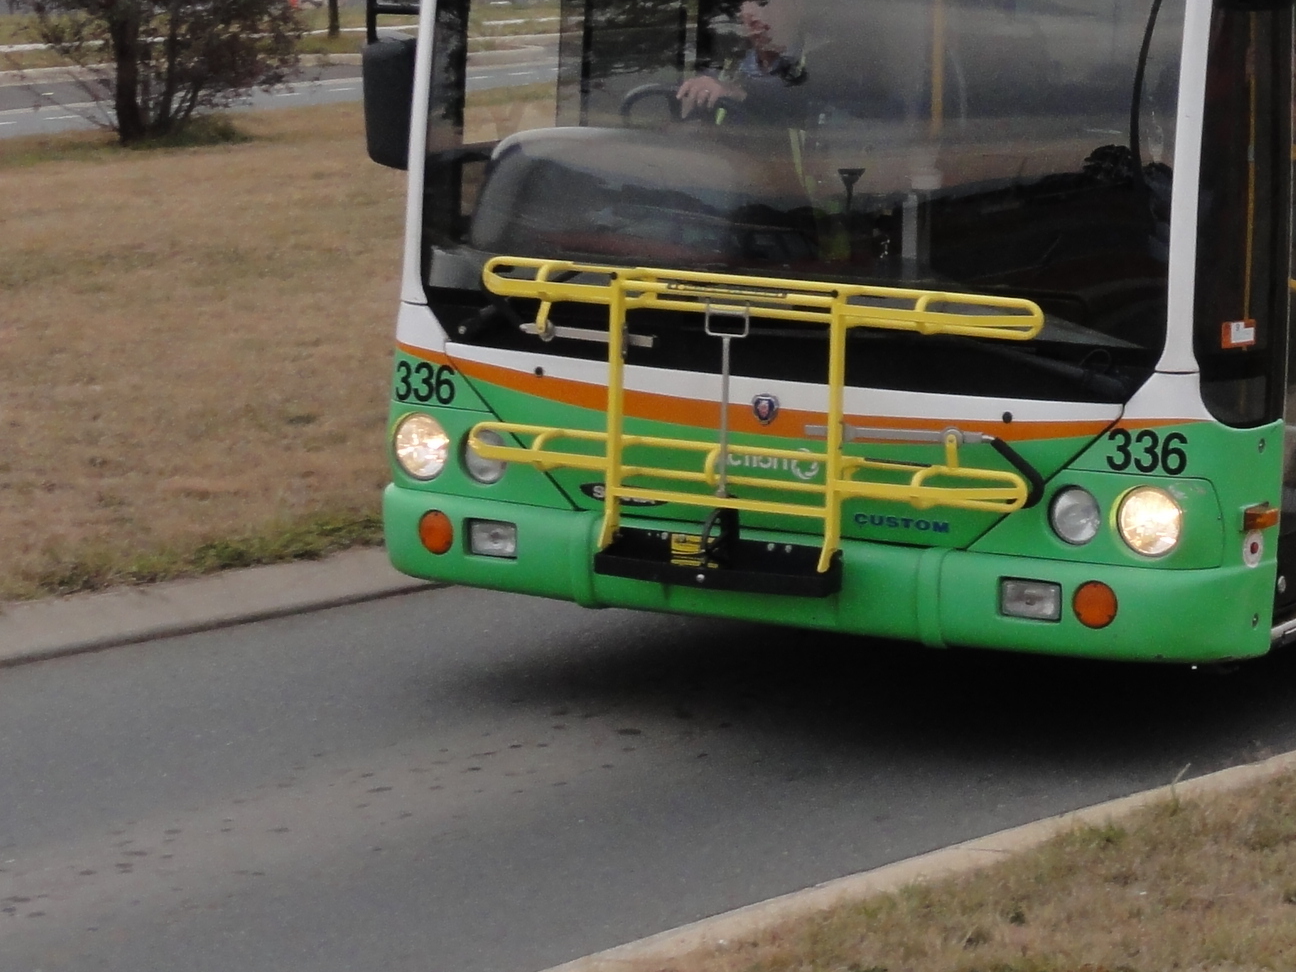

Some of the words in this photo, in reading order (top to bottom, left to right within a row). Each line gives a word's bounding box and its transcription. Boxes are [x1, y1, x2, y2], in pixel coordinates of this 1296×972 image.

[395, 360, 456, 405] 336
[1105, 428, 1188, 476] 336
[854, 513, 950, 534] CUSTOM
